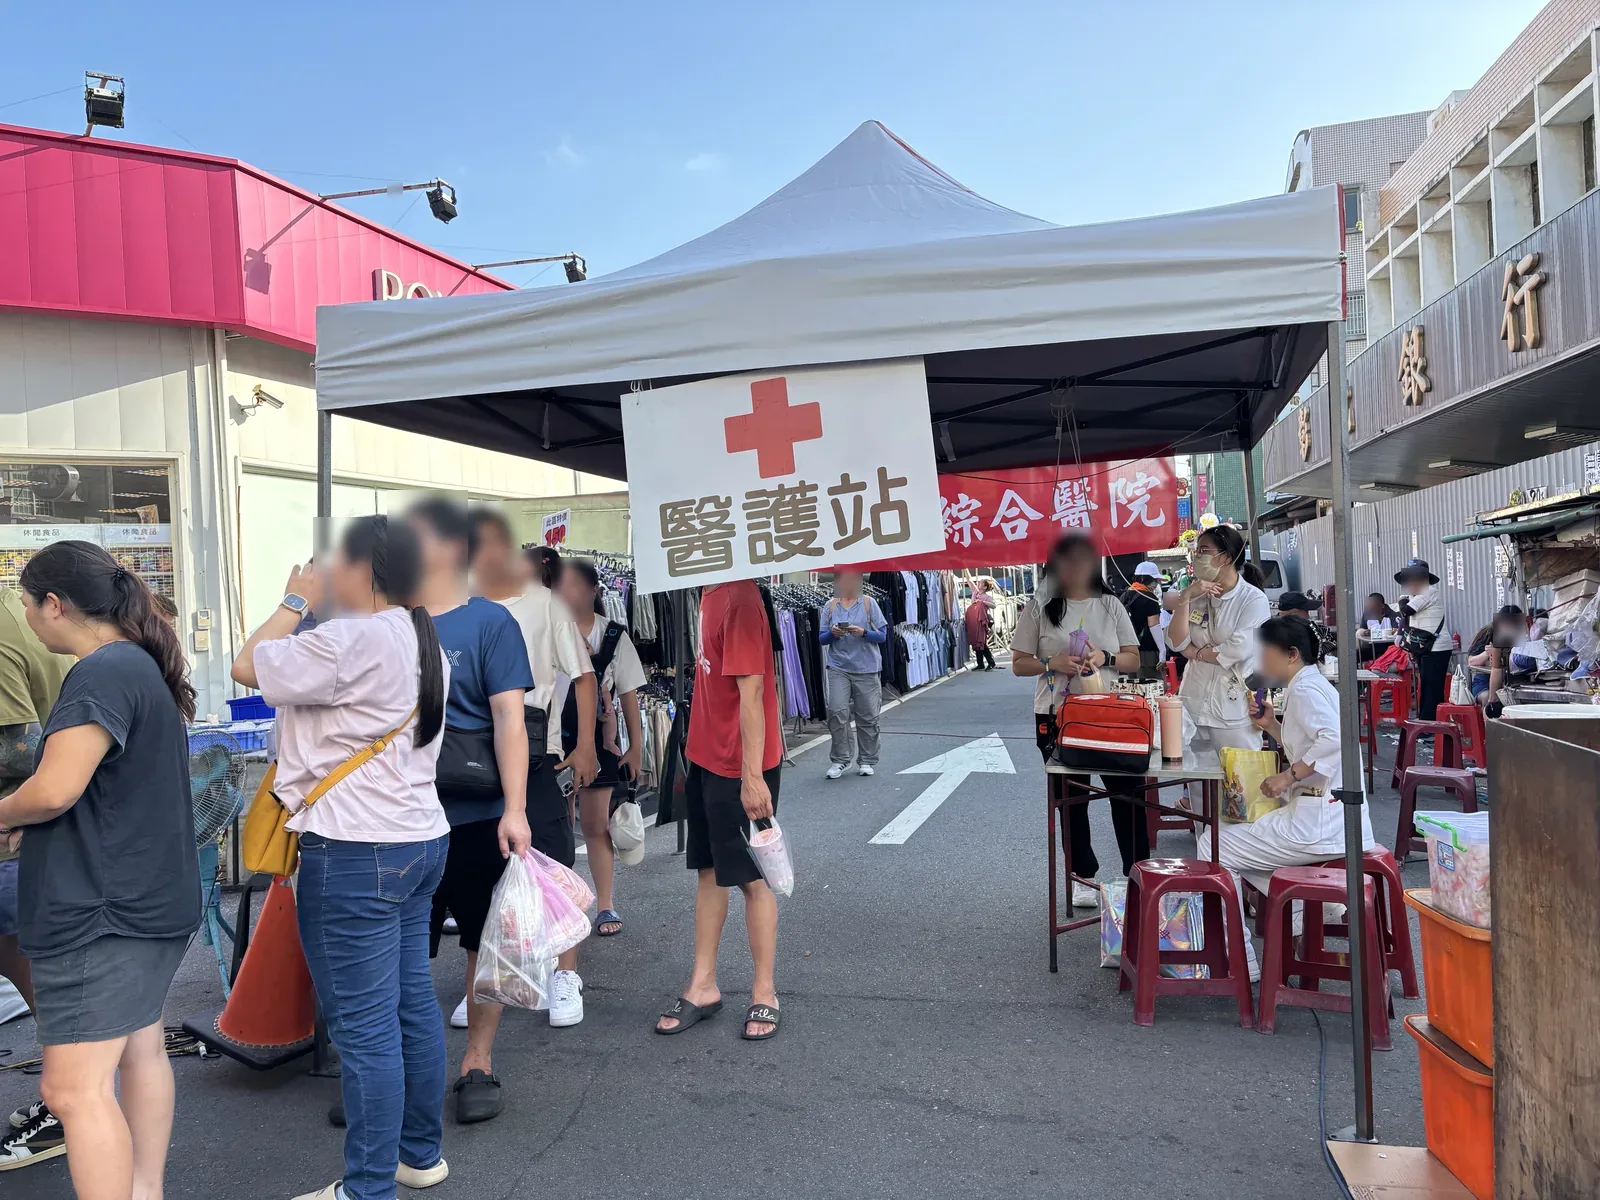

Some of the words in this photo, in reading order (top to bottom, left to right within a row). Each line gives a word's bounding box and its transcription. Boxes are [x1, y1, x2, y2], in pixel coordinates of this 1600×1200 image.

[658, 466, 911, 577] 醫護站
[941, 471, 1167, 548] 綜合醫院
